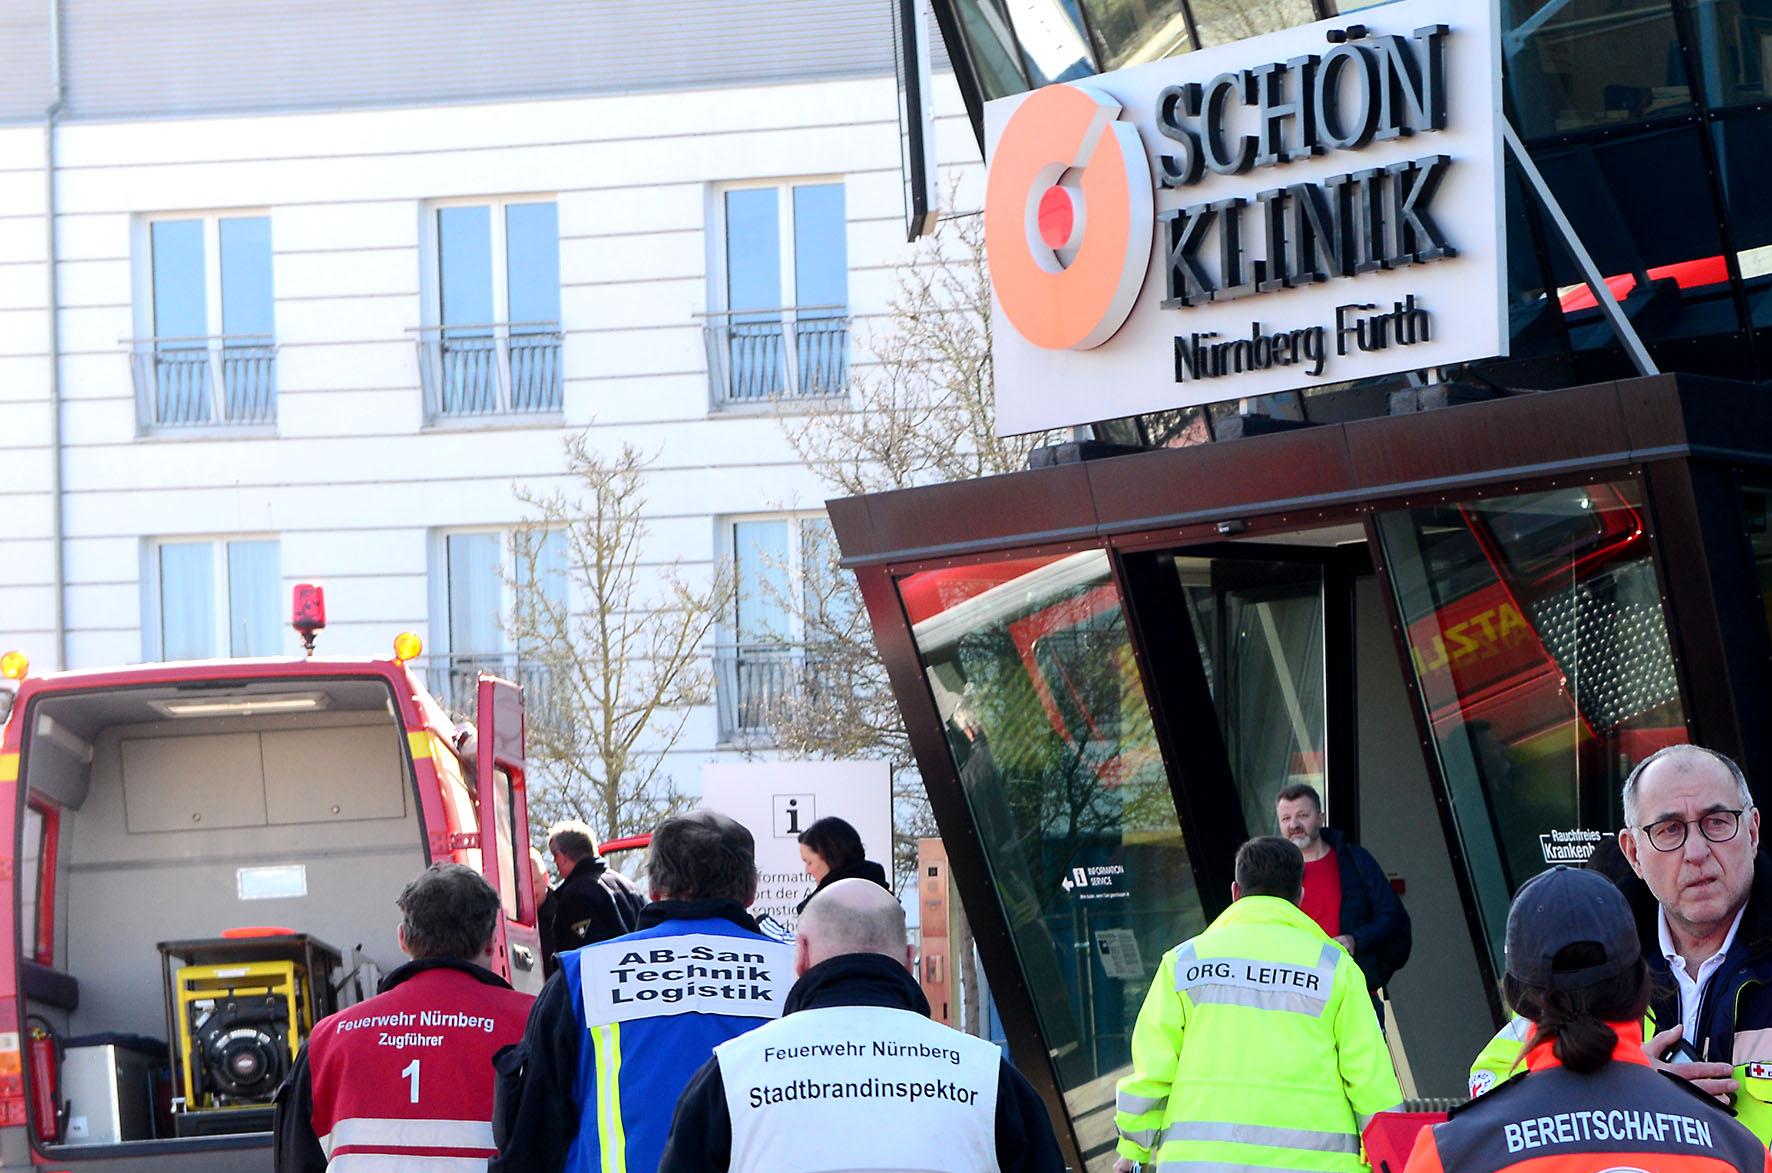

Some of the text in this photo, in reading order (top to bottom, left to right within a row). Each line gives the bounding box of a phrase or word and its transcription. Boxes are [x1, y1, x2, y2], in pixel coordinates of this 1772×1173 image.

[1155, 24, 1449, 190] SCHÖN
[1157, 154, 1456, 311] KLINIK
[1174, 294, 1431, 383] Nürnberg Fürth
[1551, 829, 1601, 842] Rauchfreies
[1091, 876, 1112, 886] SERVICE
[776, 887, 798, 899] der
[618, 946, 765, 966] AB-San
[610, 965, 772, 983] Technik
[1186, 963, 1320, 991] ORG. LEITER
[611, 982, 774, 1003] Logistik
[336, 1011, 495, 1034] Feuerwehr Nürnberg
[378, 1033, 444, 1049] Zugführer
[764, 1041, 961, 1065] Feuerwehr Nürnberg
[402, 1059, 421, 1104] 1
[749, 1078, 979, 1109] Stadtbrandinspektor
[1504, 1109, 1713, 1153] BEREITSCHAFTEN
